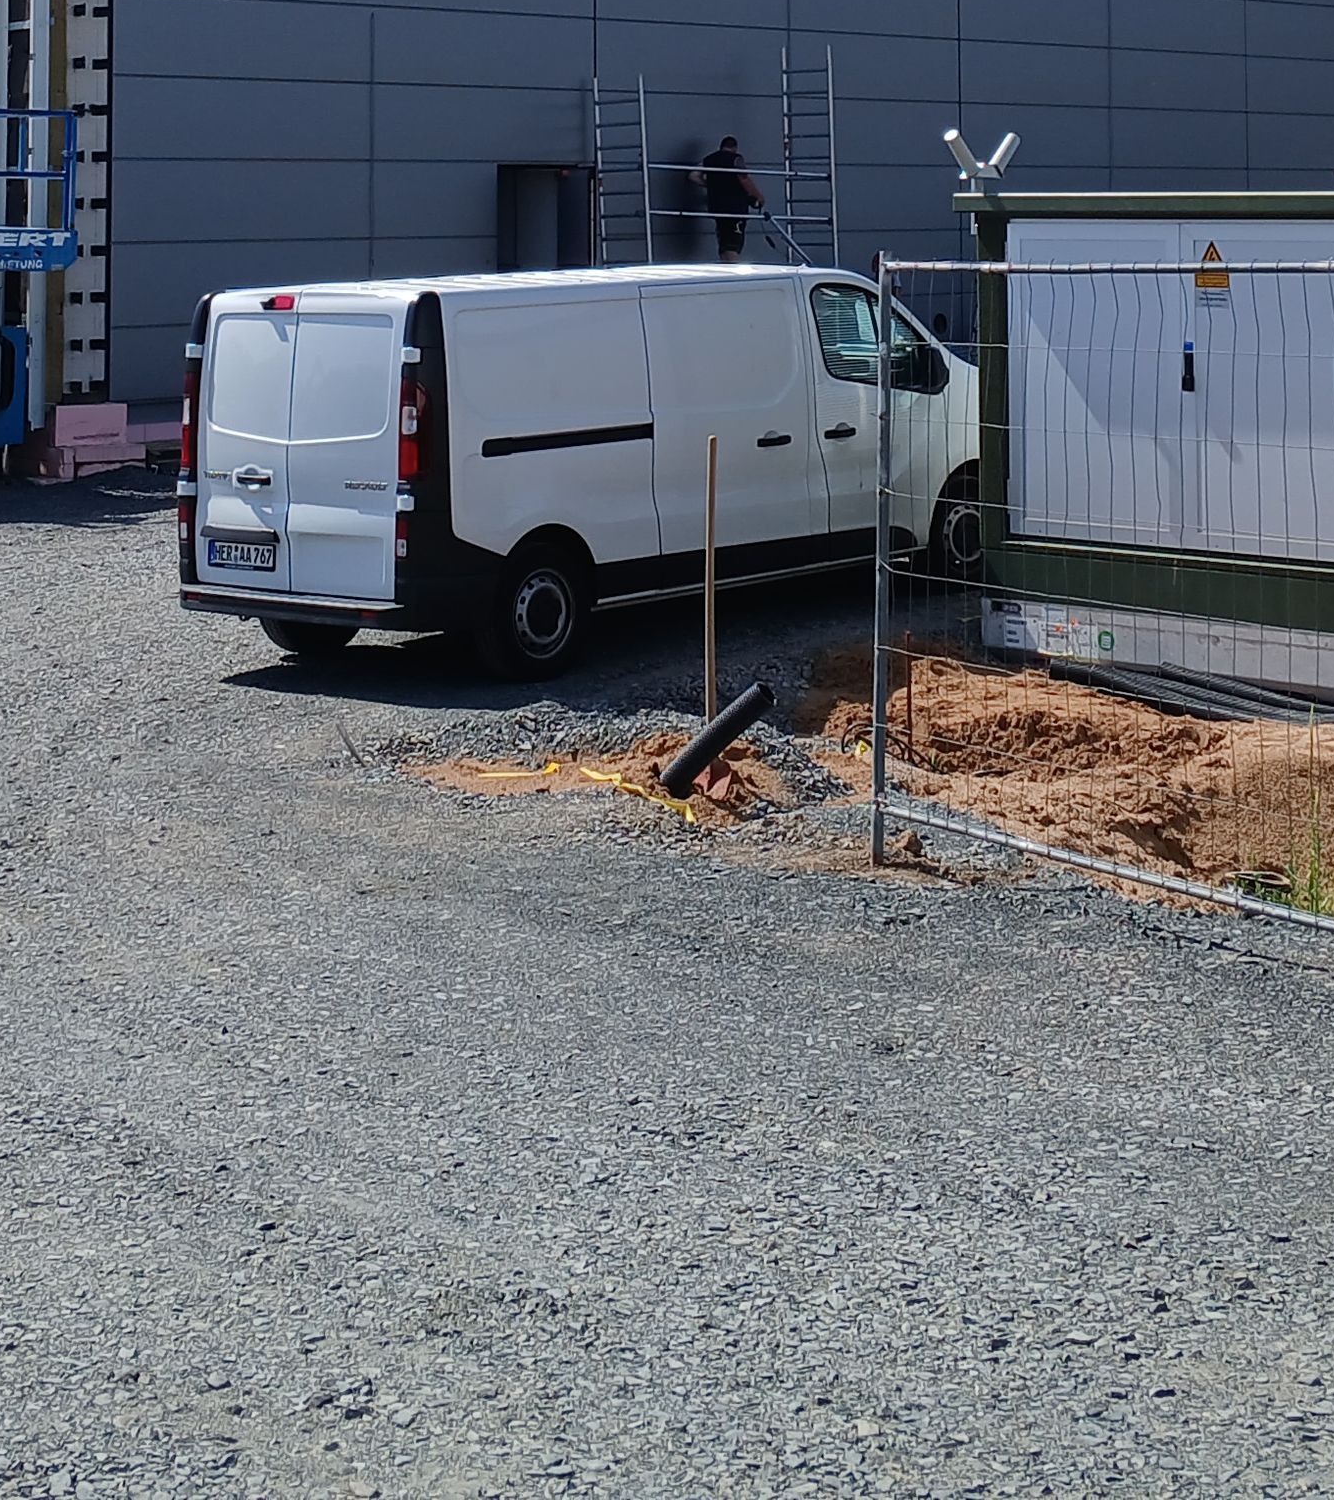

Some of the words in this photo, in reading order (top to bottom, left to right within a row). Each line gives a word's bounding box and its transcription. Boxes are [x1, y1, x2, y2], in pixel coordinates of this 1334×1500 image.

[215, 544, 233, 562] HER
[239, 545, 252, 563] AA
[253, 546, 272, 565] 767
